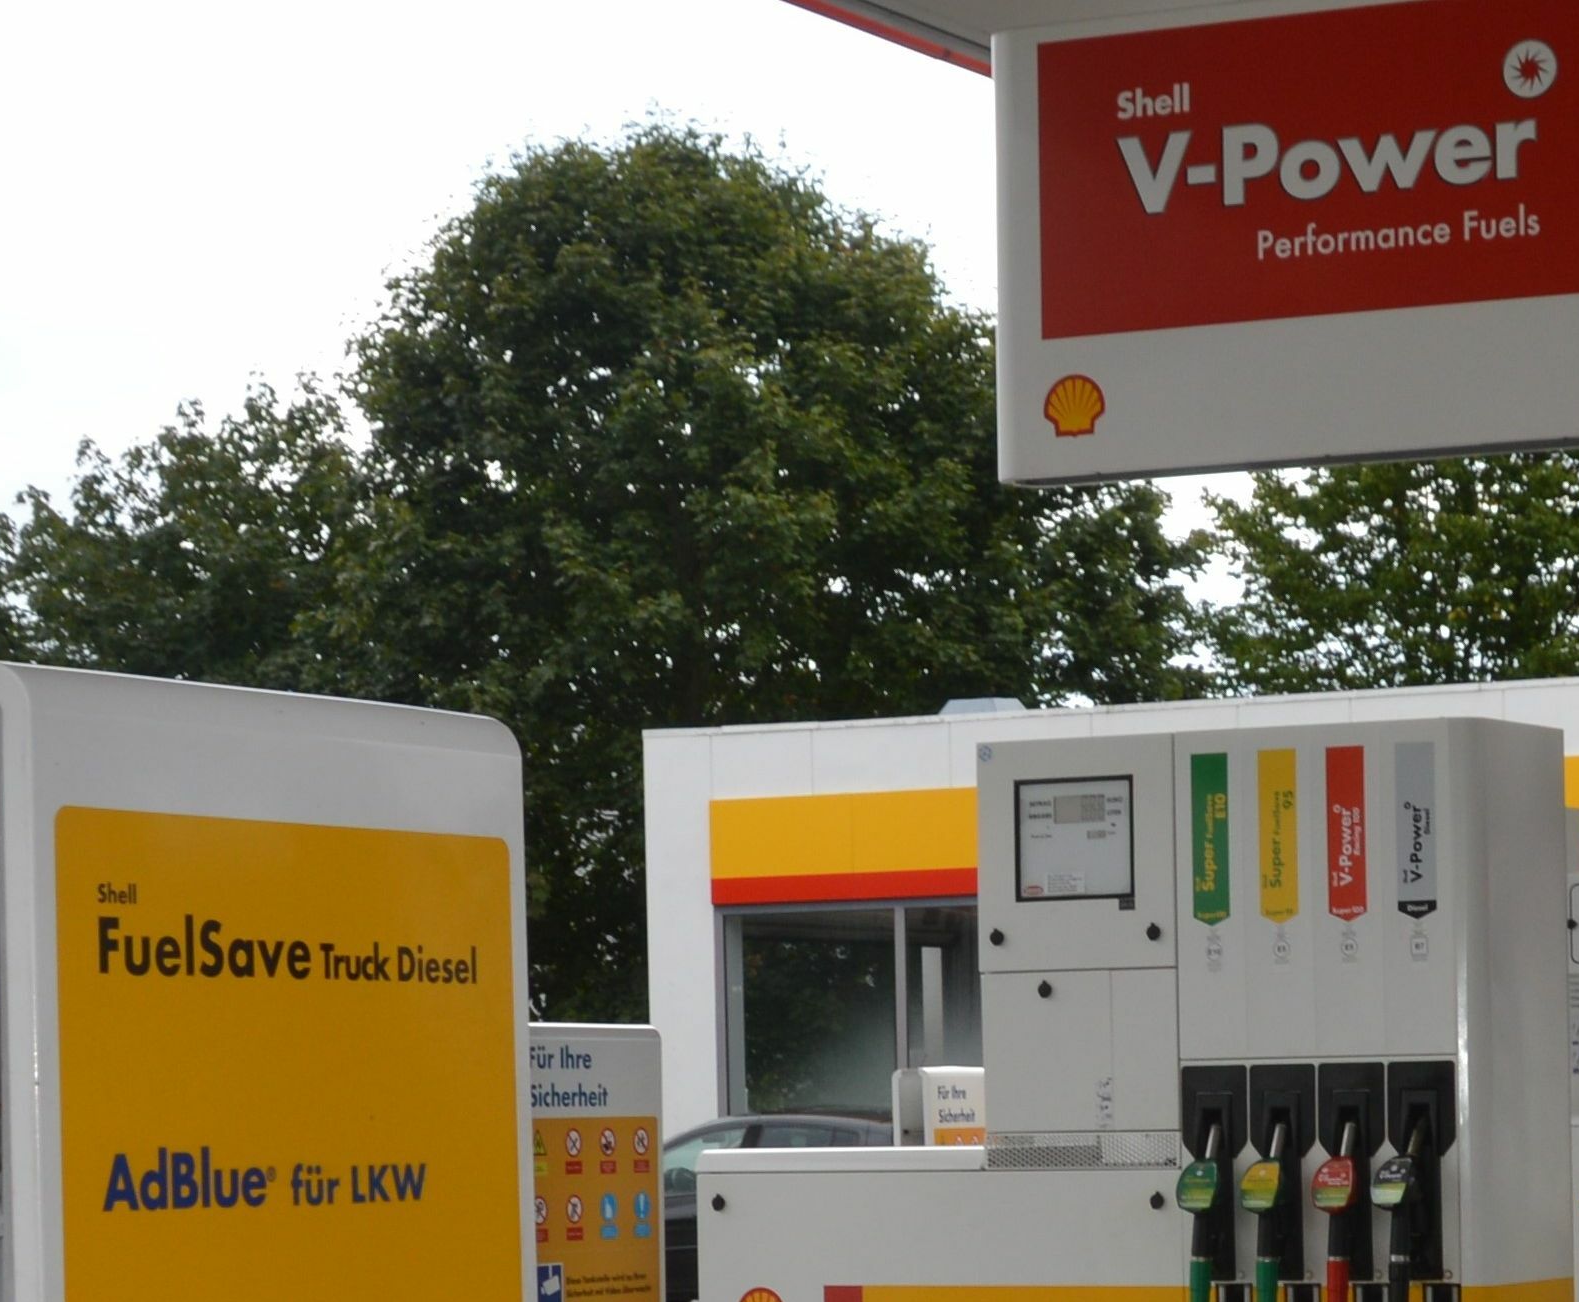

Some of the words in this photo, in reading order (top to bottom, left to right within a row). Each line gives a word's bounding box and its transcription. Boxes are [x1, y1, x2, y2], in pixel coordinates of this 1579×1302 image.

[1117, 82, 1190, 119] Shell
[1116, 118, 1538, 215] V-Power
[1257, 222, 1451, 260] Performance
[1463, 203, 1541, 241] Fuels
[1214, 792, 1227, 819] E10
[1282, 790, 1293, 810] 95
[1270, 838, 1285, 889] Super
[1338, 807, 1353, 886] V-Power
[1410, 804, 1423, 883] V-Power
[1202, 841, 1218, 892] Super
[97, 882, 138, 905] Shell
[98, 914, 312, 980] FuelSave
[320, 941, 391, 981] Truck
[397, 945, 478, 984] Diesel
[560, 1044, 592, 1069] Ihre
[530, 1083, 608, 1108] Sicherheit
[937, 1085, 950, 1100] Für
[938, 1108, 975, 1123] Sicherheit
[290, 1162, 340, 1206] für
[351, 1163, 426, 1204] LKW
